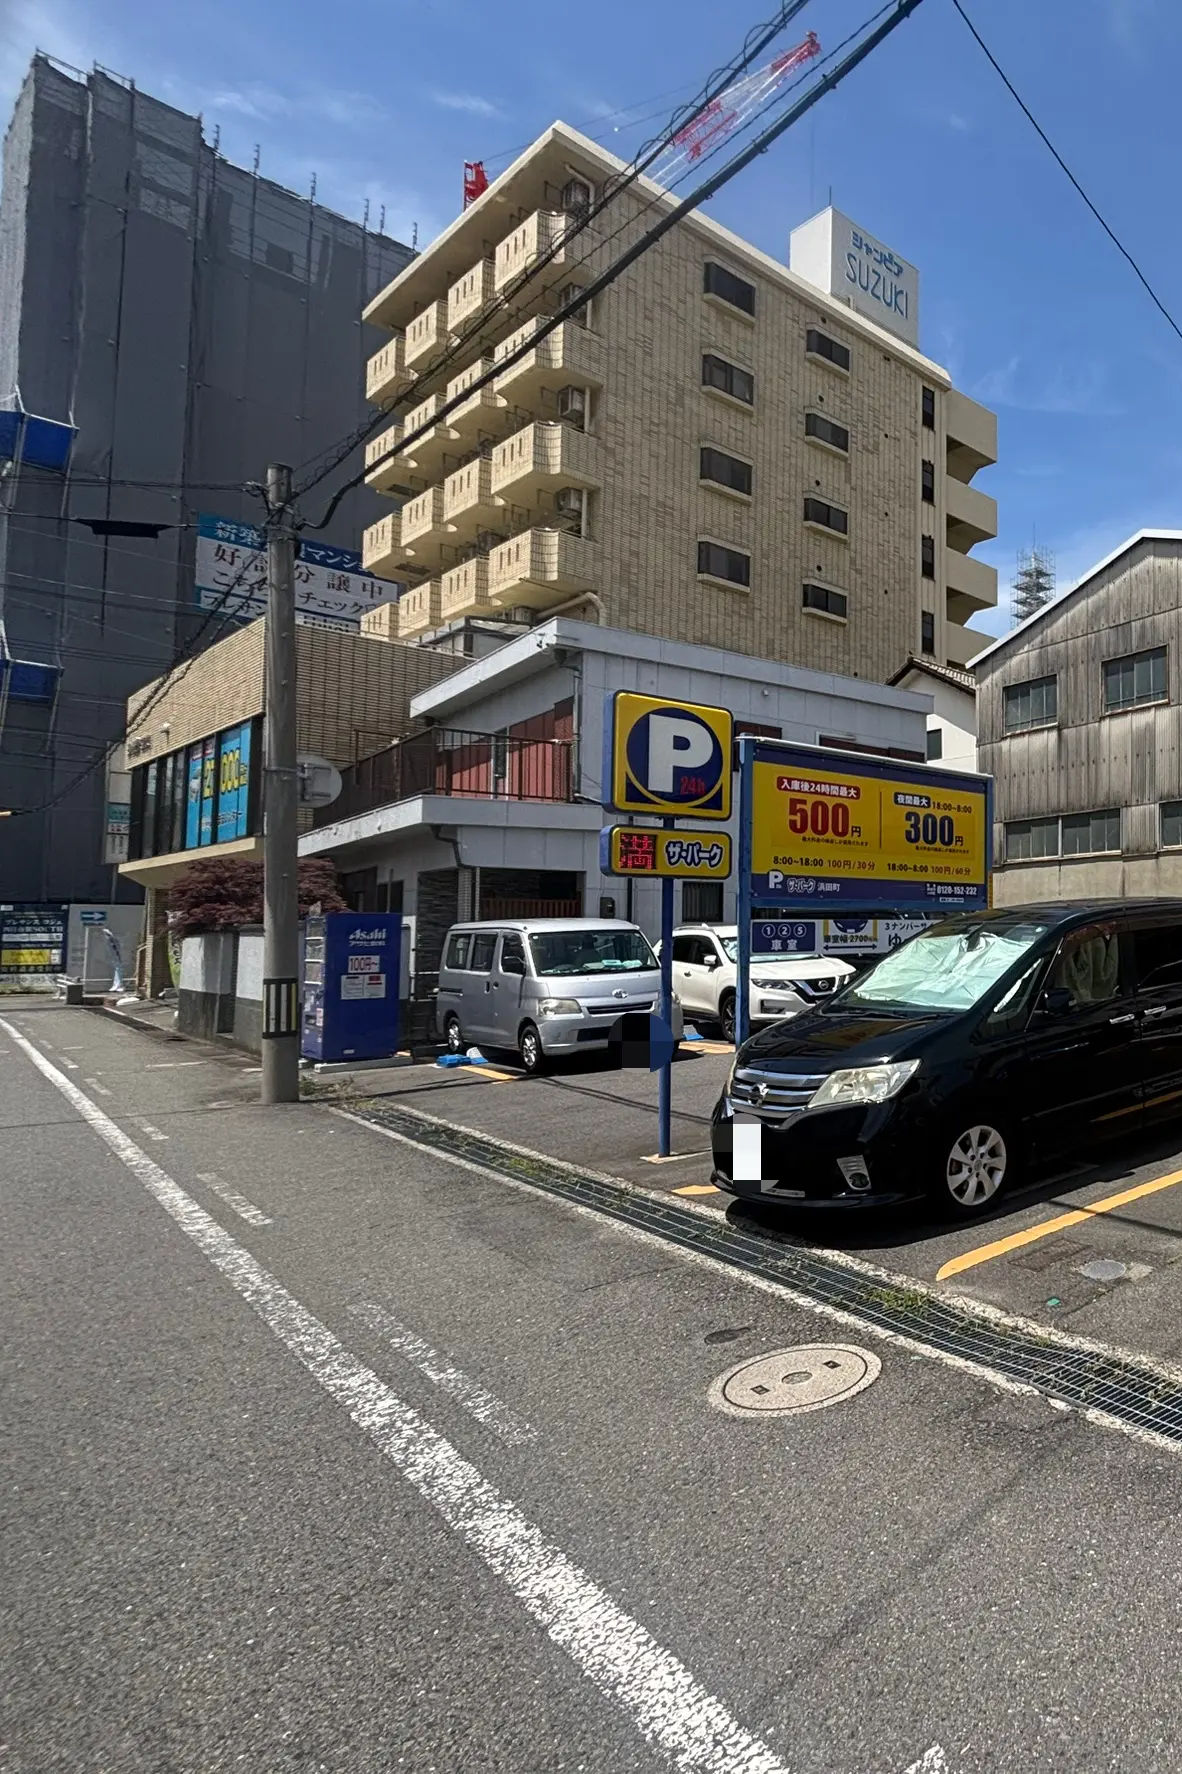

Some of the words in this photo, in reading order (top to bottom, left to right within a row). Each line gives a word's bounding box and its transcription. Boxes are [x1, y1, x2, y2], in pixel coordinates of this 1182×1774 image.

[851, 230, 903, 277] シャンピア
[845, 252, 908, 320] SUZUKI
[648, 714, 713, 793] P
[680, 776, 705, 795] 24h
[781, 779, 858, 798] 入庫後24時間最大
[897, 794, 928, 807] 夜間最大
[789, 798, 861, 838] 500円
[905, 811, 964, 847] 300円
[665, 841, 723, 868] ザ・パーク
[787, 878, 816, 893] ザ・パーク
[818, 882, 840, 892] 浜田町
[349, 928, 387, 940] Asahi
